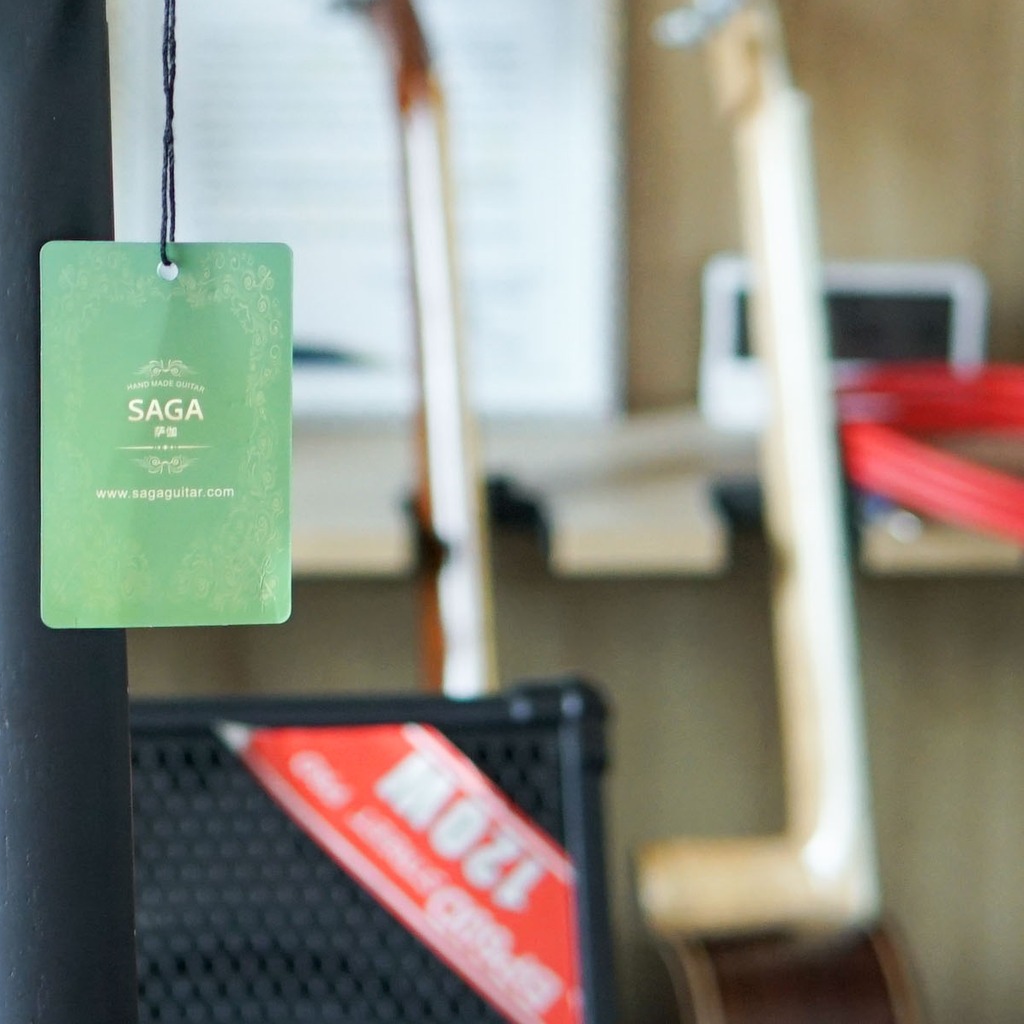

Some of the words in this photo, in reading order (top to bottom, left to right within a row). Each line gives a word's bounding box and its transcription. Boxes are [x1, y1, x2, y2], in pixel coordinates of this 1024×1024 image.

[127, 381, 149, 391] HAND
[151, 379, 173, 387] MADE
[128, 398, 204, 422] SAGA
[96, 486, 235, 501] www.sagaguitar.com
[376, 748, 544, 912] 120W
